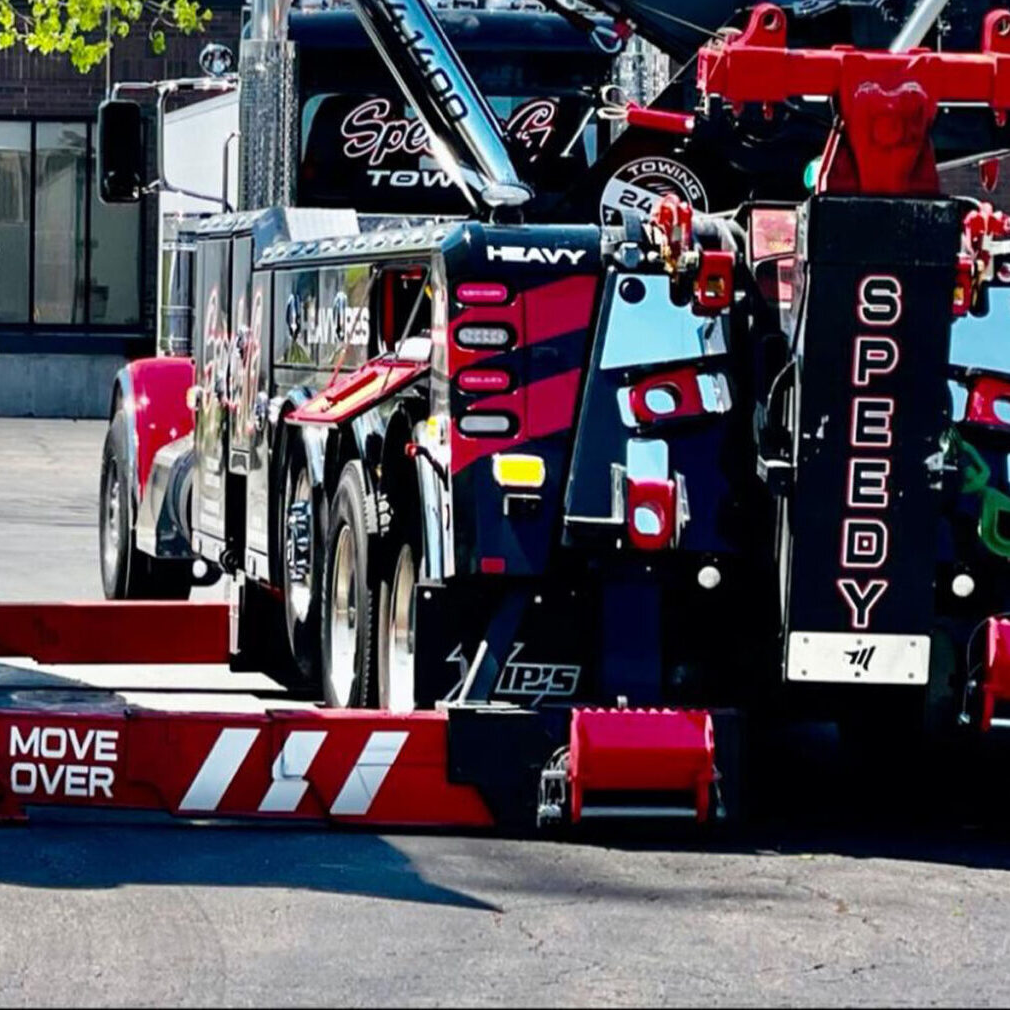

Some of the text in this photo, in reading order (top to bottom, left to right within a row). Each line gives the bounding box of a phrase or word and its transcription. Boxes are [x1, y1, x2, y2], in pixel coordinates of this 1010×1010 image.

[341, 98, 433, 166] Spe
[367, 170, 457, 187] TOW
[627, 161, 701, 200] TOWING
[487, 245, 586, 265] HEAVY
[837, 276, 902, 629] SPEEDY
[9, 725, 119, 761] MOVE
[11, 762, 115, 798] OVER
